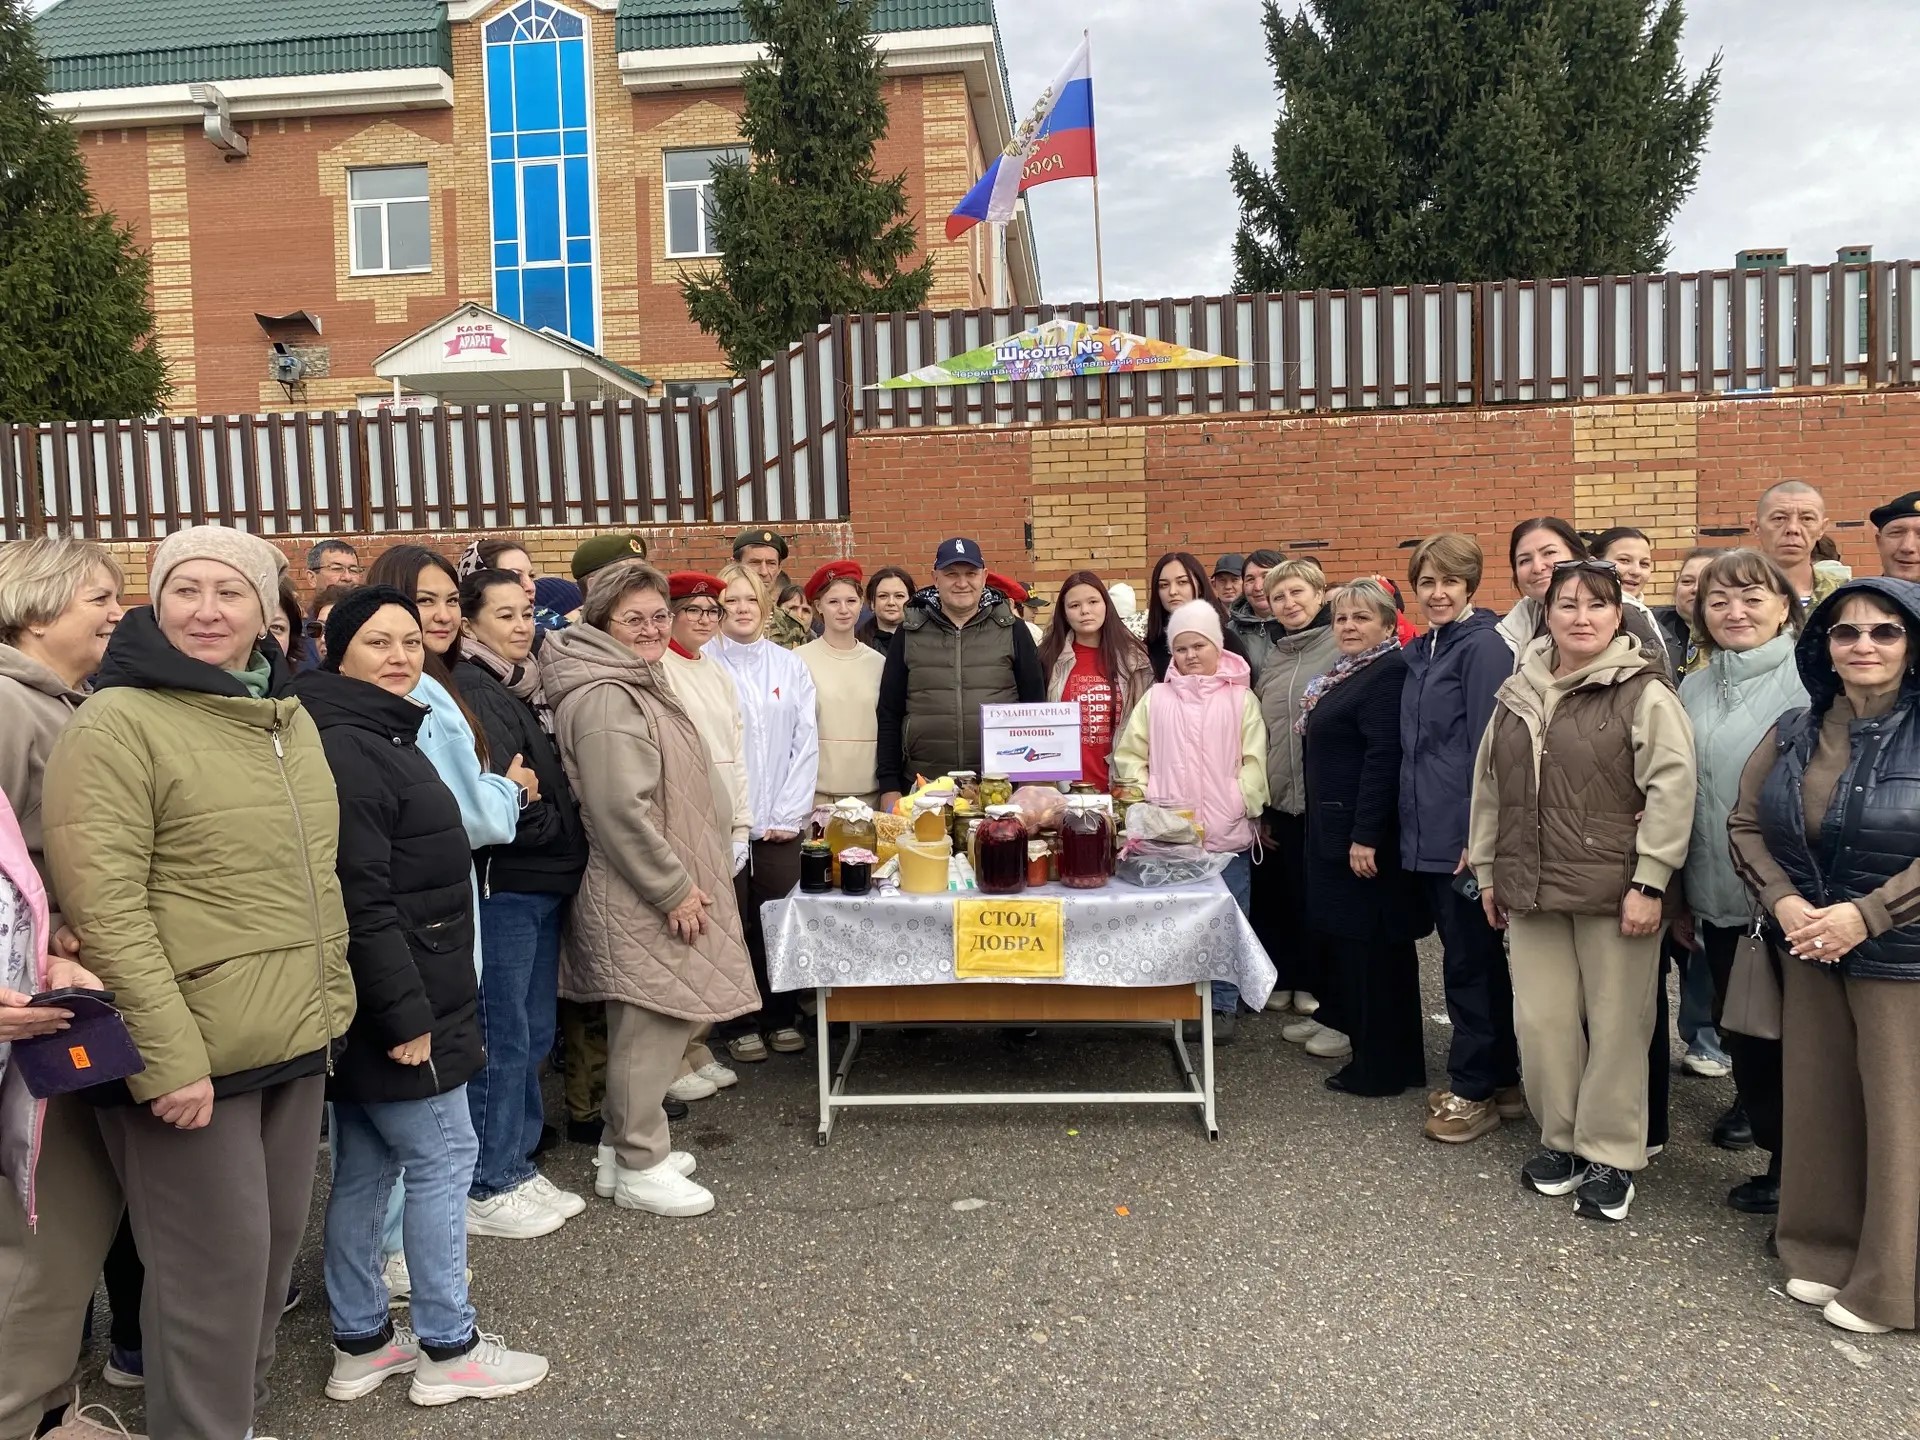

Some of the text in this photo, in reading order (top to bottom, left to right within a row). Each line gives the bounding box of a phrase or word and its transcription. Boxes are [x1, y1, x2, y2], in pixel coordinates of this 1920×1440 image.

[460, 334, 492, 349] АРАРАТ
[996, 337, 1122, 361] Школа № 1
[951, 355, 1171, 379] Черемшанский муниципальный район
[990, 707, 1071, 718] ГУМАНИТАРНАЯ
[1009, 729, 1054, 738] ПОМОЩЬ
[979, 911, 1037, 928] СТОЛ
[970, 934, 1045, 953] ДОБРА
